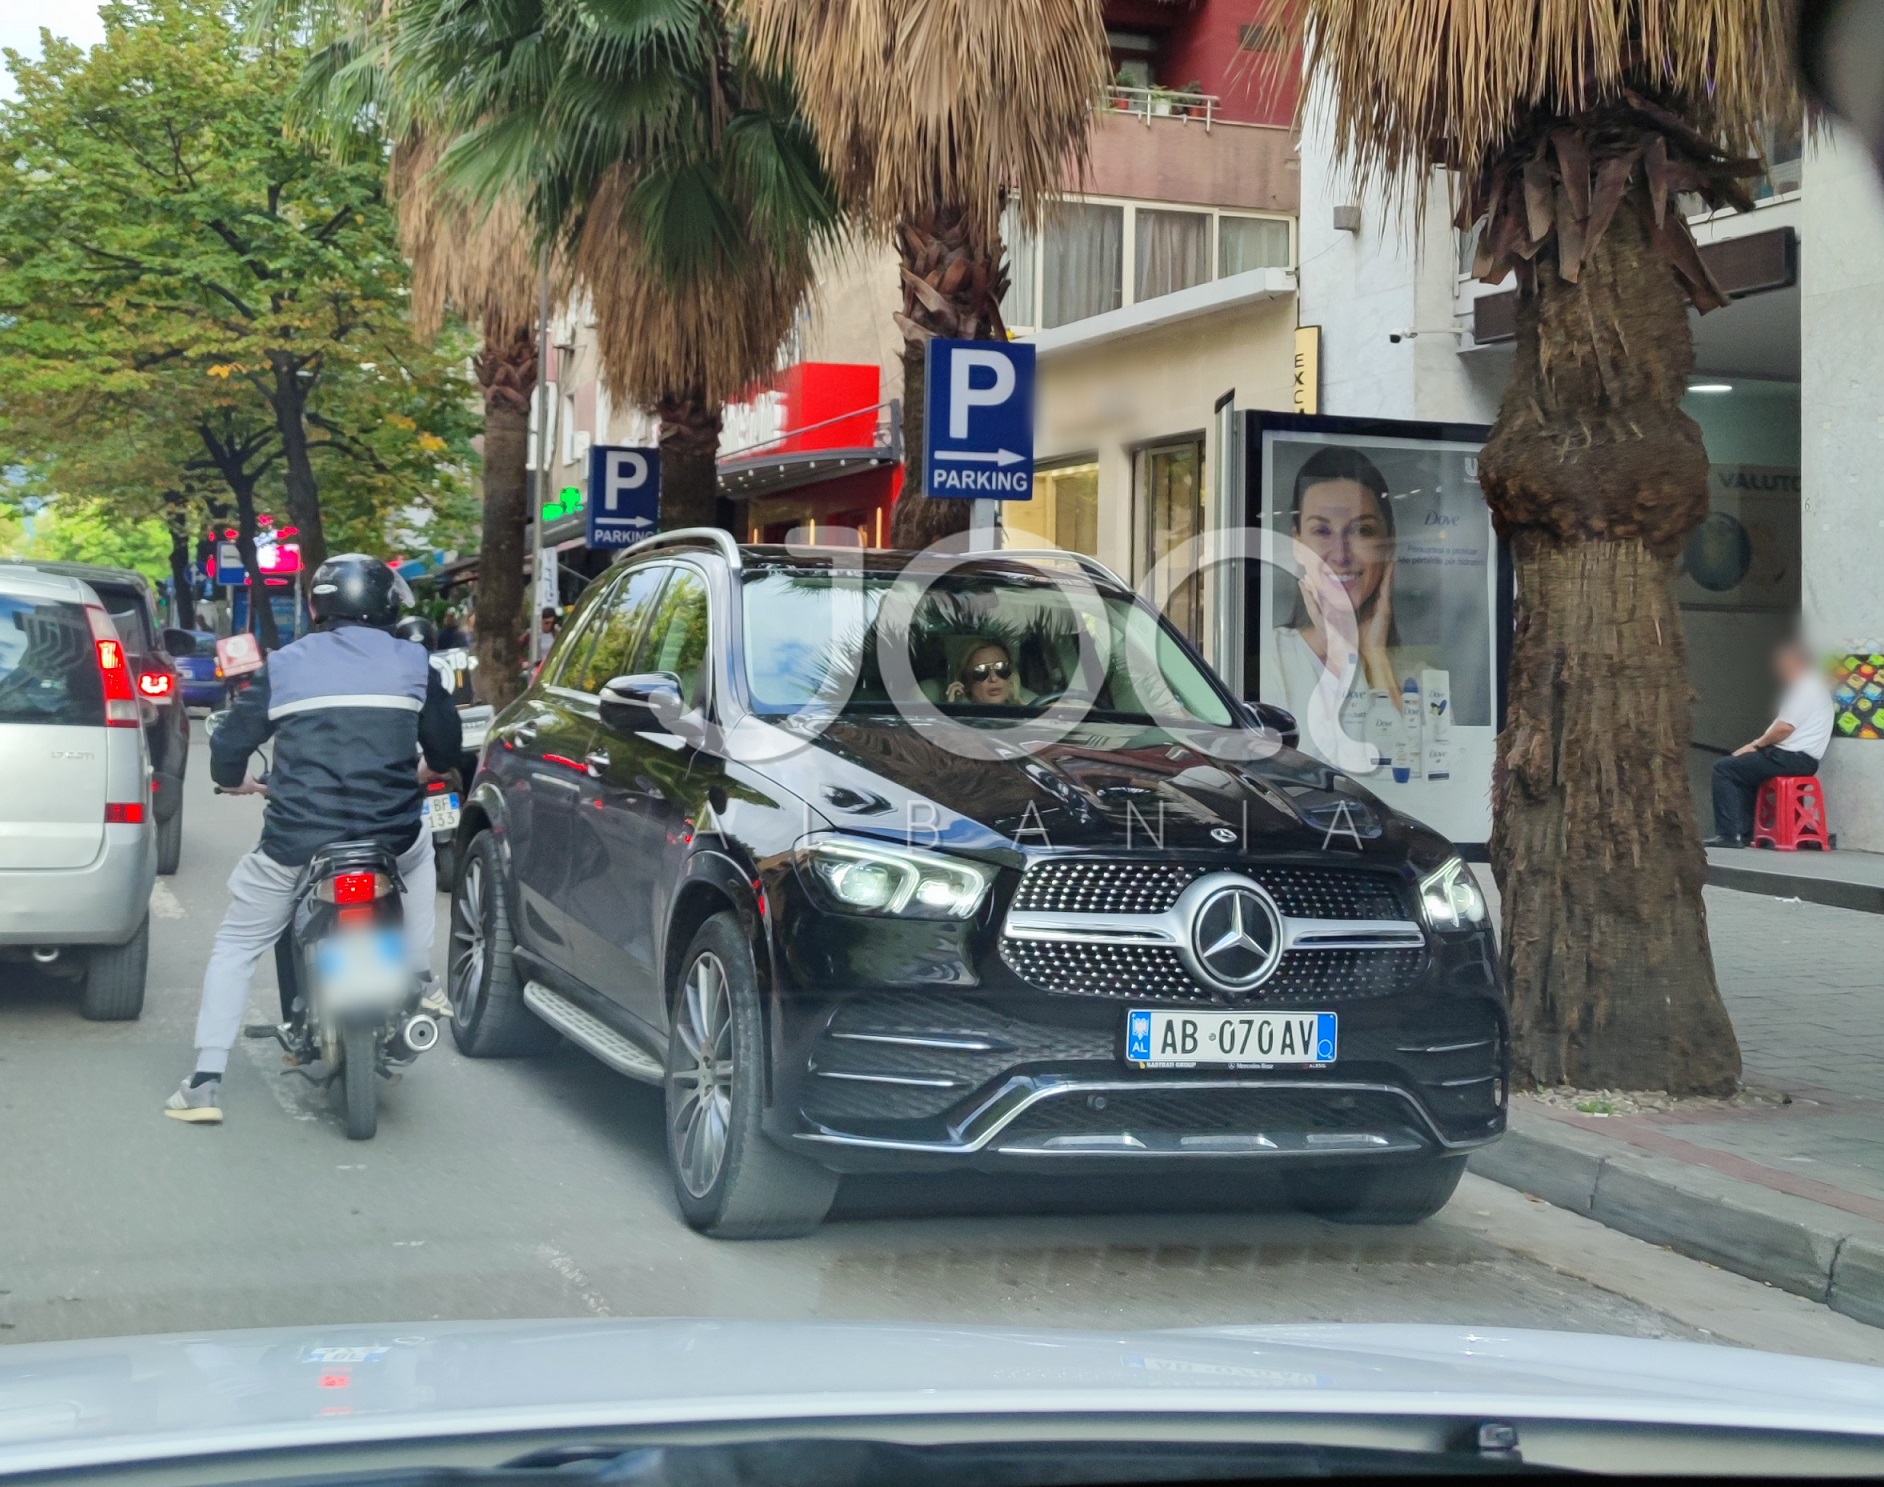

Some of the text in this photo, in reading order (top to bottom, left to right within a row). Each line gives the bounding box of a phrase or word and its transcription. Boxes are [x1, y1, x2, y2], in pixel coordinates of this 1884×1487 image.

[1294, 352, 1305, 413] EXC
[949, 348, 1016, 439] P
[604, 450, 649, 510] P
[933, 469, 1028, 491] PARKING
[1424, 510, 1460, 527] Dove
[1375, 718, 1393, 727] Dove
[433, 798, 449, 812] BF
[429, 811, 456, 828] 133
[1132, 1041, 1148, 1053] AL
